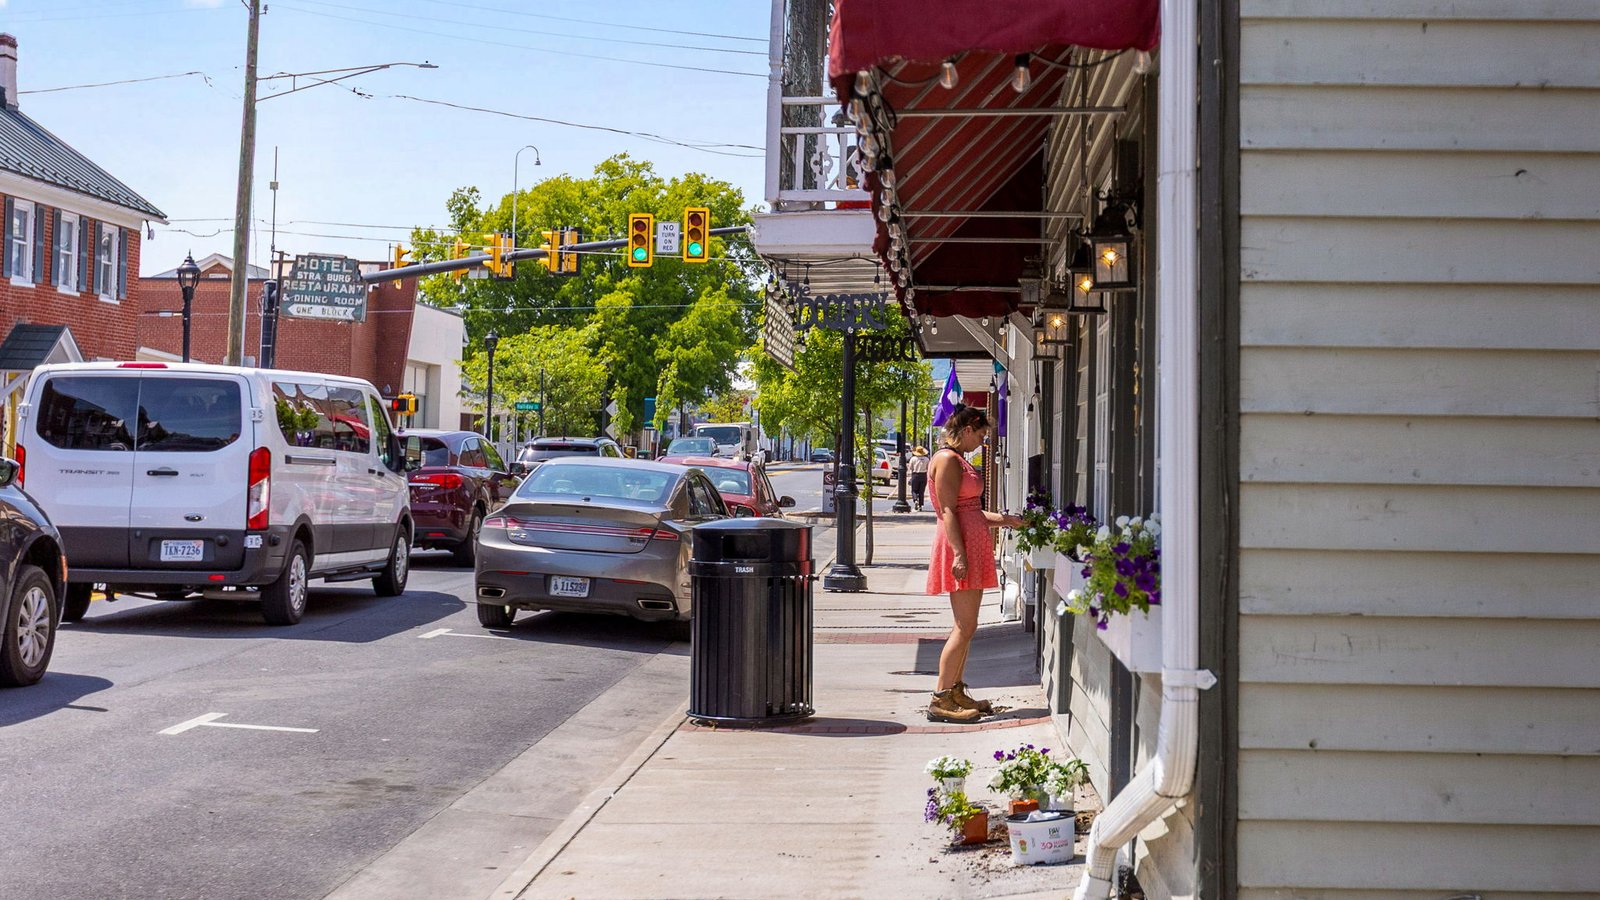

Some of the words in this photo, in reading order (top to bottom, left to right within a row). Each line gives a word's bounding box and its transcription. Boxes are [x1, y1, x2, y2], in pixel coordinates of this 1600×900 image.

[297, 257, 353, 273] HOTEL
[283, 280, 364, 294] RESTAURANT
[282, 293, 290, 301] &
[294, 294, 328, 303] DINING
[334, 296, 363, 306] ROOM
[296, 306, 313, 314] ONE
[321, 307, 349, 317] BLOCK
[164, 545, 201, 556] TKN-7236
